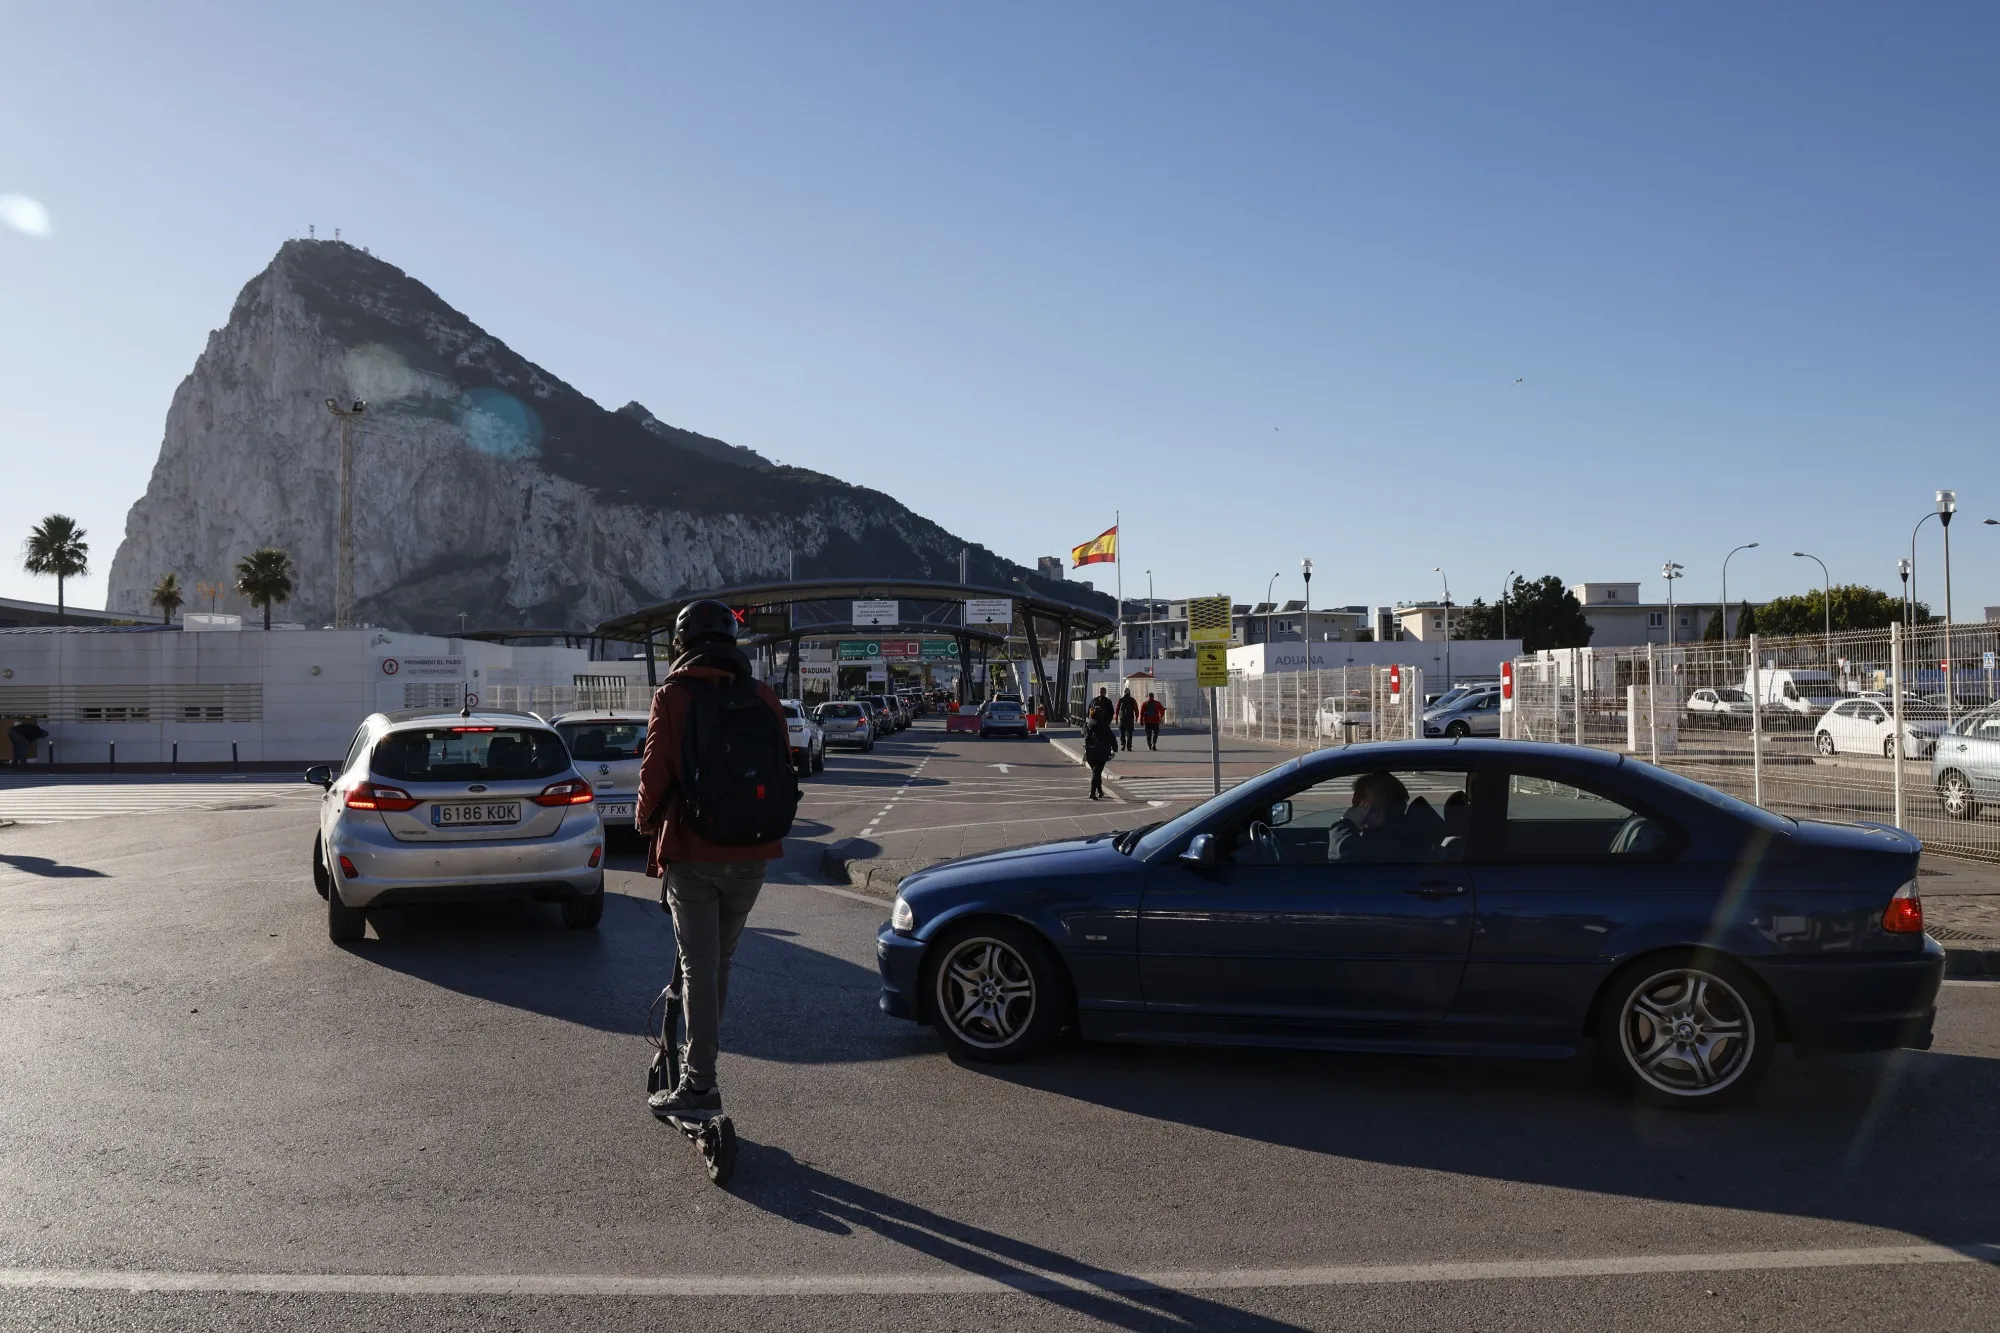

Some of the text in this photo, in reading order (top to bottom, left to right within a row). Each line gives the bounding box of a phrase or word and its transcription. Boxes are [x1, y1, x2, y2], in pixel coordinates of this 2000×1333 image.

[1275, 656, 1324, 665] ADUANA
[443, 805, 516, 821] 6186 KDK
[610, 806, 627, 814] FXK
